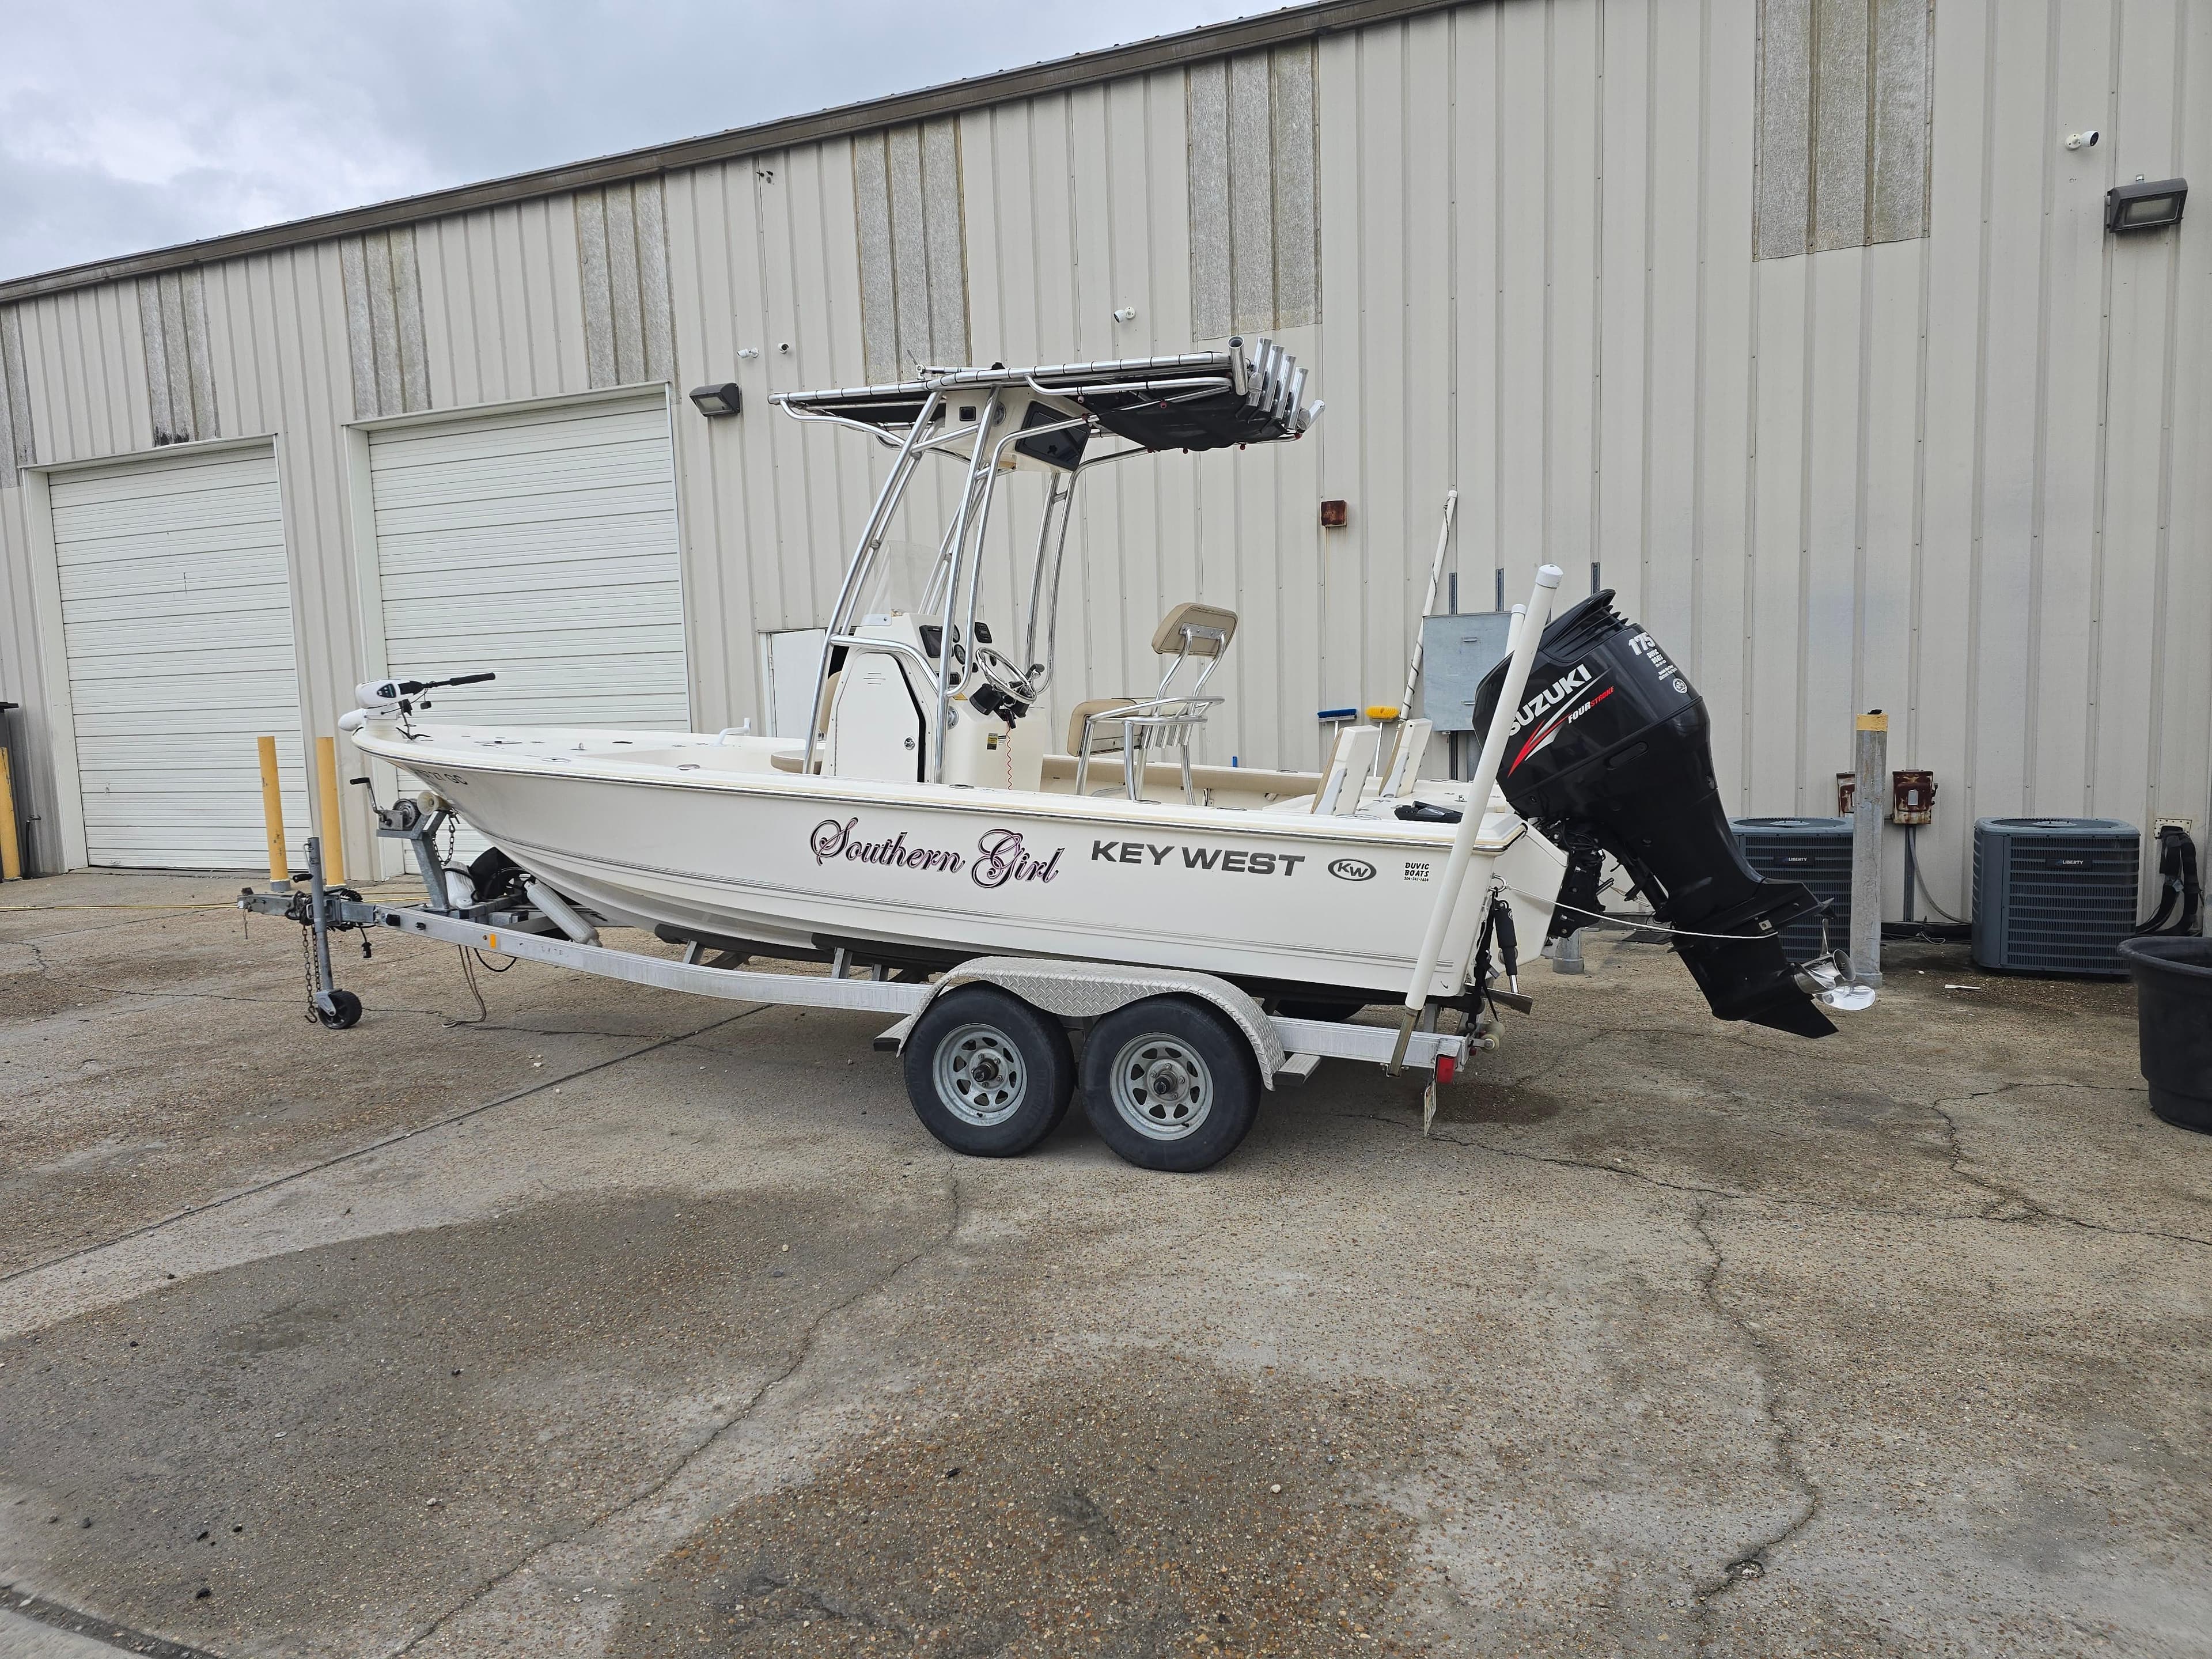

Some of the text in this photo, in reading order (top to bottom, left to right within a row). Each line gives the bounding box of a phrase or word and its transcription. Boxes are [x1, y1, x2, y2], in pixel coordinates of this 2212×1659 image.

[1628, 632, 1656, 656] 175
[1509, 664, 1592, 736] SUZUKI
[444, 774, 468, 785] GC
[810, 817, 1066, 888] Southern Girl
[1091, 840, 1305, 876] KEY WEST
[1336, 862, 1369, 877] KW
